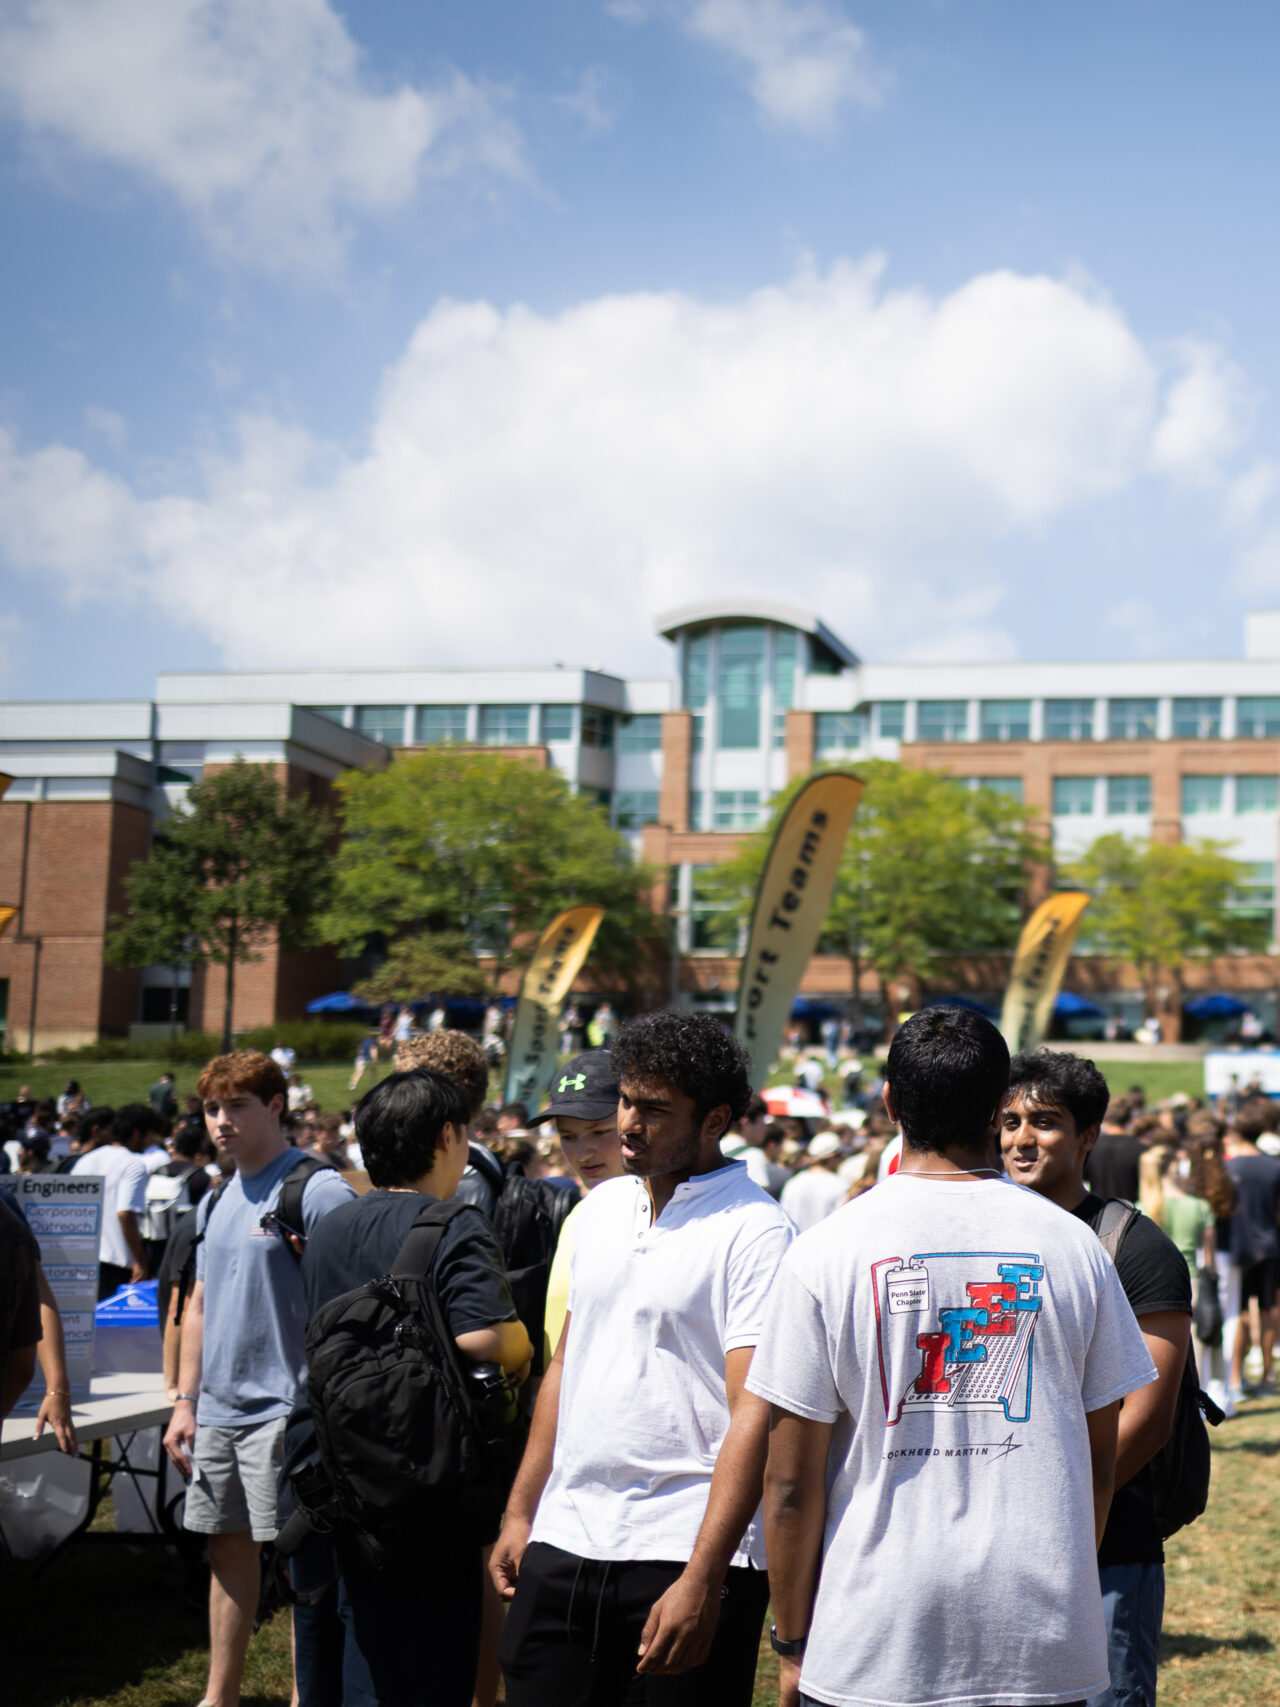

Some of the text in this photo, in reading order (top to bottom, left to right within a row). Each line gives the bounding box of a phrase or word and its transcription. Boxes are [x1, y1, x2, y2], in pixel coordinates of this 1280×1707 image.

[768, 809, 828, 933] Teams
[23, 1179, 100, 1198] Engineers
[28, 1206, 96, 1218] Corporate
[31, 1221, 92, 1232] Outreach
[45, 1268, 97, 1279] torship
[909, 1289, 927, 1297] State
[883, 1448, 989, 1460] OCKHEED MARTIN
